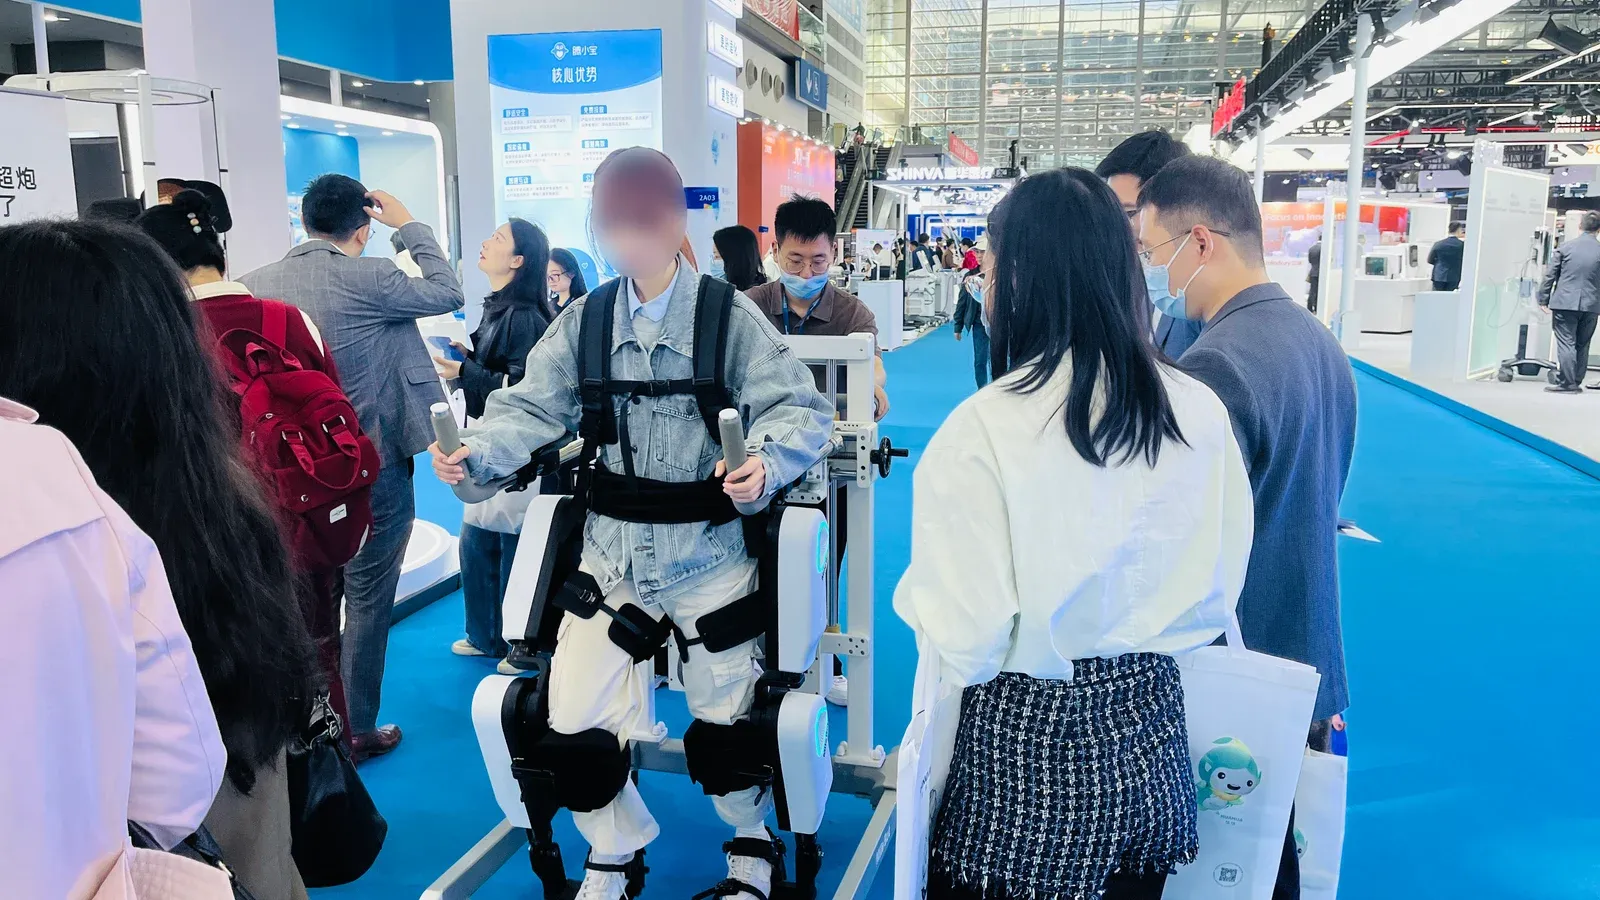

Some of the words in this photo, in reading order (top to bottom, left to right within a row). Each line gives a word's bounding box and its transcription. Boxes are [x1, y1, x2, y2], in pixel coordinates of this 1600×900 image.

[551, 66, 598, 83] 核心优势
[886, 167, 943, 181] SHINVA
[698, 194, 716, 202] 2A03
[1264, 213, 1291, 221] Focus
[1293, 213, 1305, 221] on
